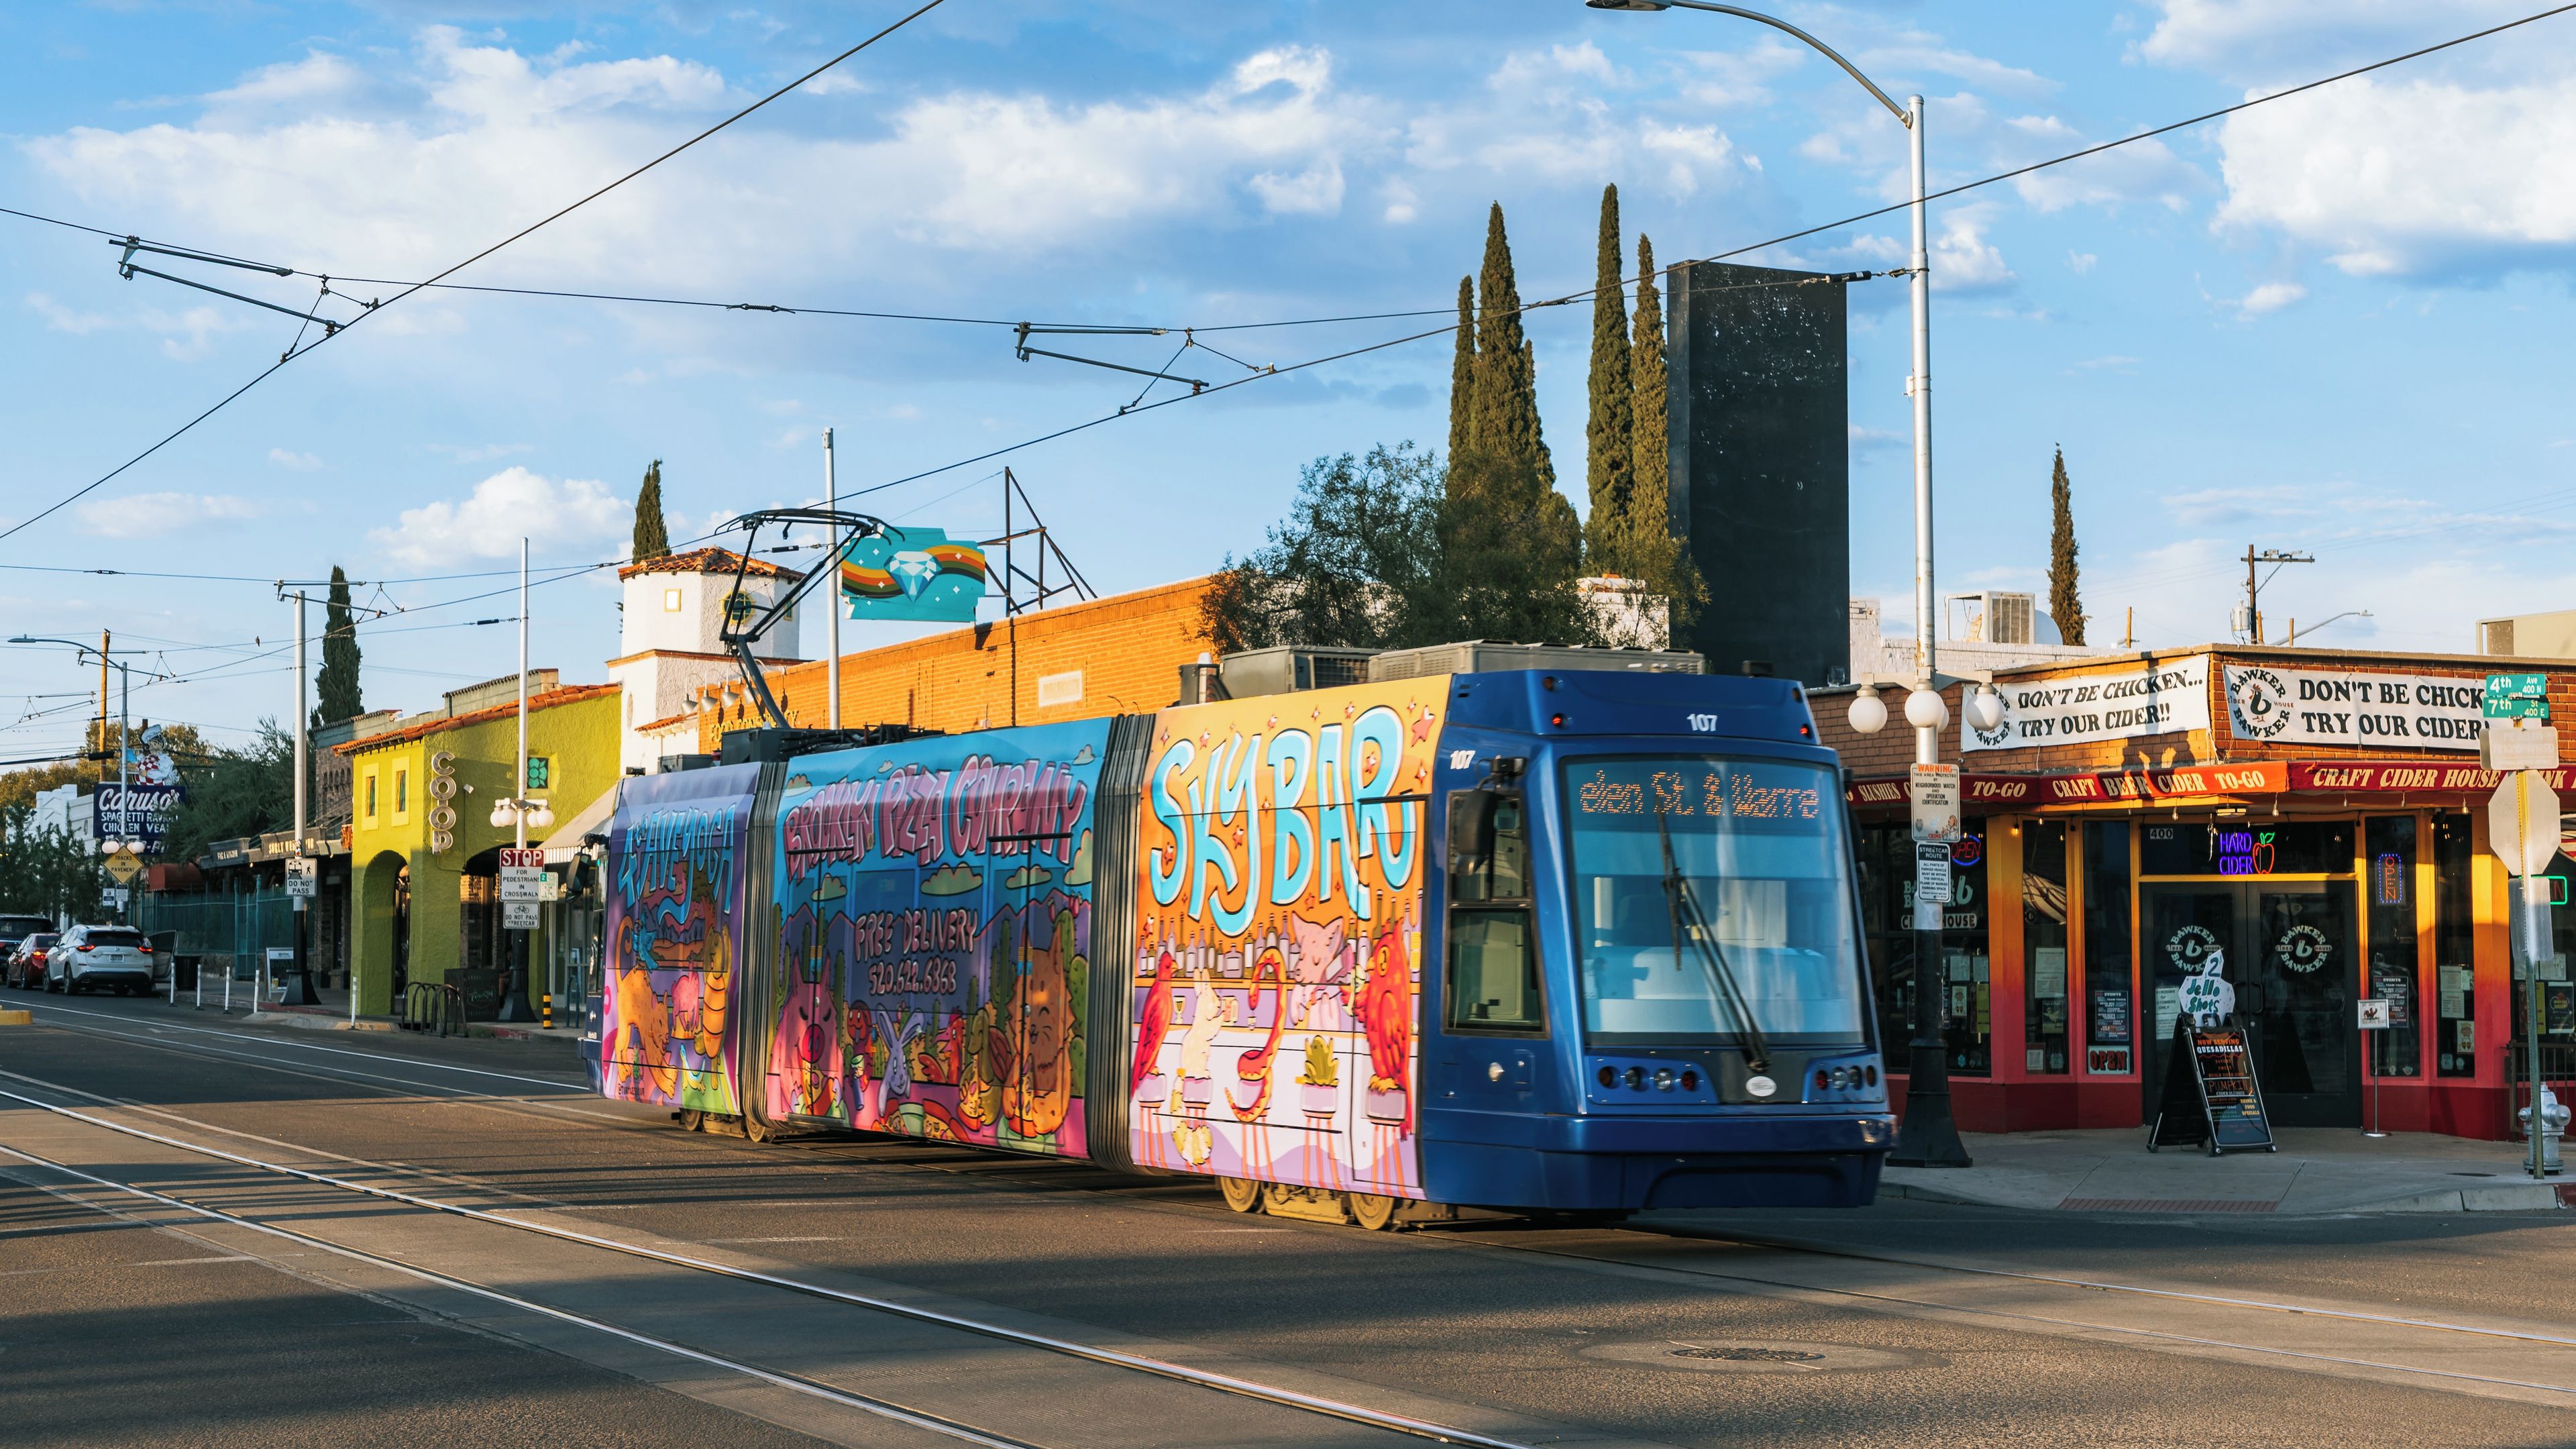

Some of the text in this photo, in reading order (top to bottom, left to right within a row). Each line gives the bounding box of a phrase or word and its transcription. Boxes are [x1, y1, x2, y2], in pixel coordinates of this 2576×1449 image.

[2017, 686, 2075, 708] DON'T
[2074, 685, 2100, 703] BE
[2103, 669, 2203, 700] CHICKEN...
[2231, 669, 2286, 698] BAWKER
[2489, 676, 2538, 693] 4th Ave
[2522, 685, 2536, 694] 400
[2299, 679, 2485, 710] DON'T BE CHICK
[2488, 698, 2538, 715] 7th St
[2524, 708, 2545, 716] 400 E
[1687, 713, 1718, 732] 107
[2019, 702, 2171, 737] TRY OUR CIDER!!
[2233, 707, 2290, 738] BAWKER
[2301, 712, 2351, 734] TRY
[2359, 714, 2410, 737] OUR
[1974, 720, 2010, 747] AWKER
[1450, 749, 1476, 770] 107
[1917, 765, 1953, 773] WARNING
[2052, 769, 2265, 798] CRAFT BEER CIDER TO-GO
[2313, 769, 2501, 788] CRAFT CIDER HOUSE
[1858, 782, 1902, 802] SLUSHIES
[1972, 781, 2027, 798] TO-GO
[101, 812, 144, 822] SPAGETTI
[881, 762, 951, 867] PIZZA
[948, 753, 1088, 865] COMPANY
[2151, 828, 2173, 839] 400
[2219, 833, 2252, 853] HARD
[502, 849, 543, 867] STOP
[1951, 841, 1982, 859] OPEN
[2219, 856, 2253, 875] CIDER
[2385, 857, 2397, 901] OPEN
[1943, 913, 1976, 928] OUSE
[855, 907, 977, 962] FREE DELIVERY
[2171, 925, 2215, 945] BAWKER
[2281, 925, 2326, 945] BAWKER
[2281, 952, 2328, 973] BAWKER
[869, 955, 957, 996] 520.622.6868
[2186, 979, 2220, 997] Jello
[2188, 996, 2220, 1013] Shots
[2090, 1051, 2127, 1071] OPEN
[2208, 1080, 2248, 1093] PUMPKIN
